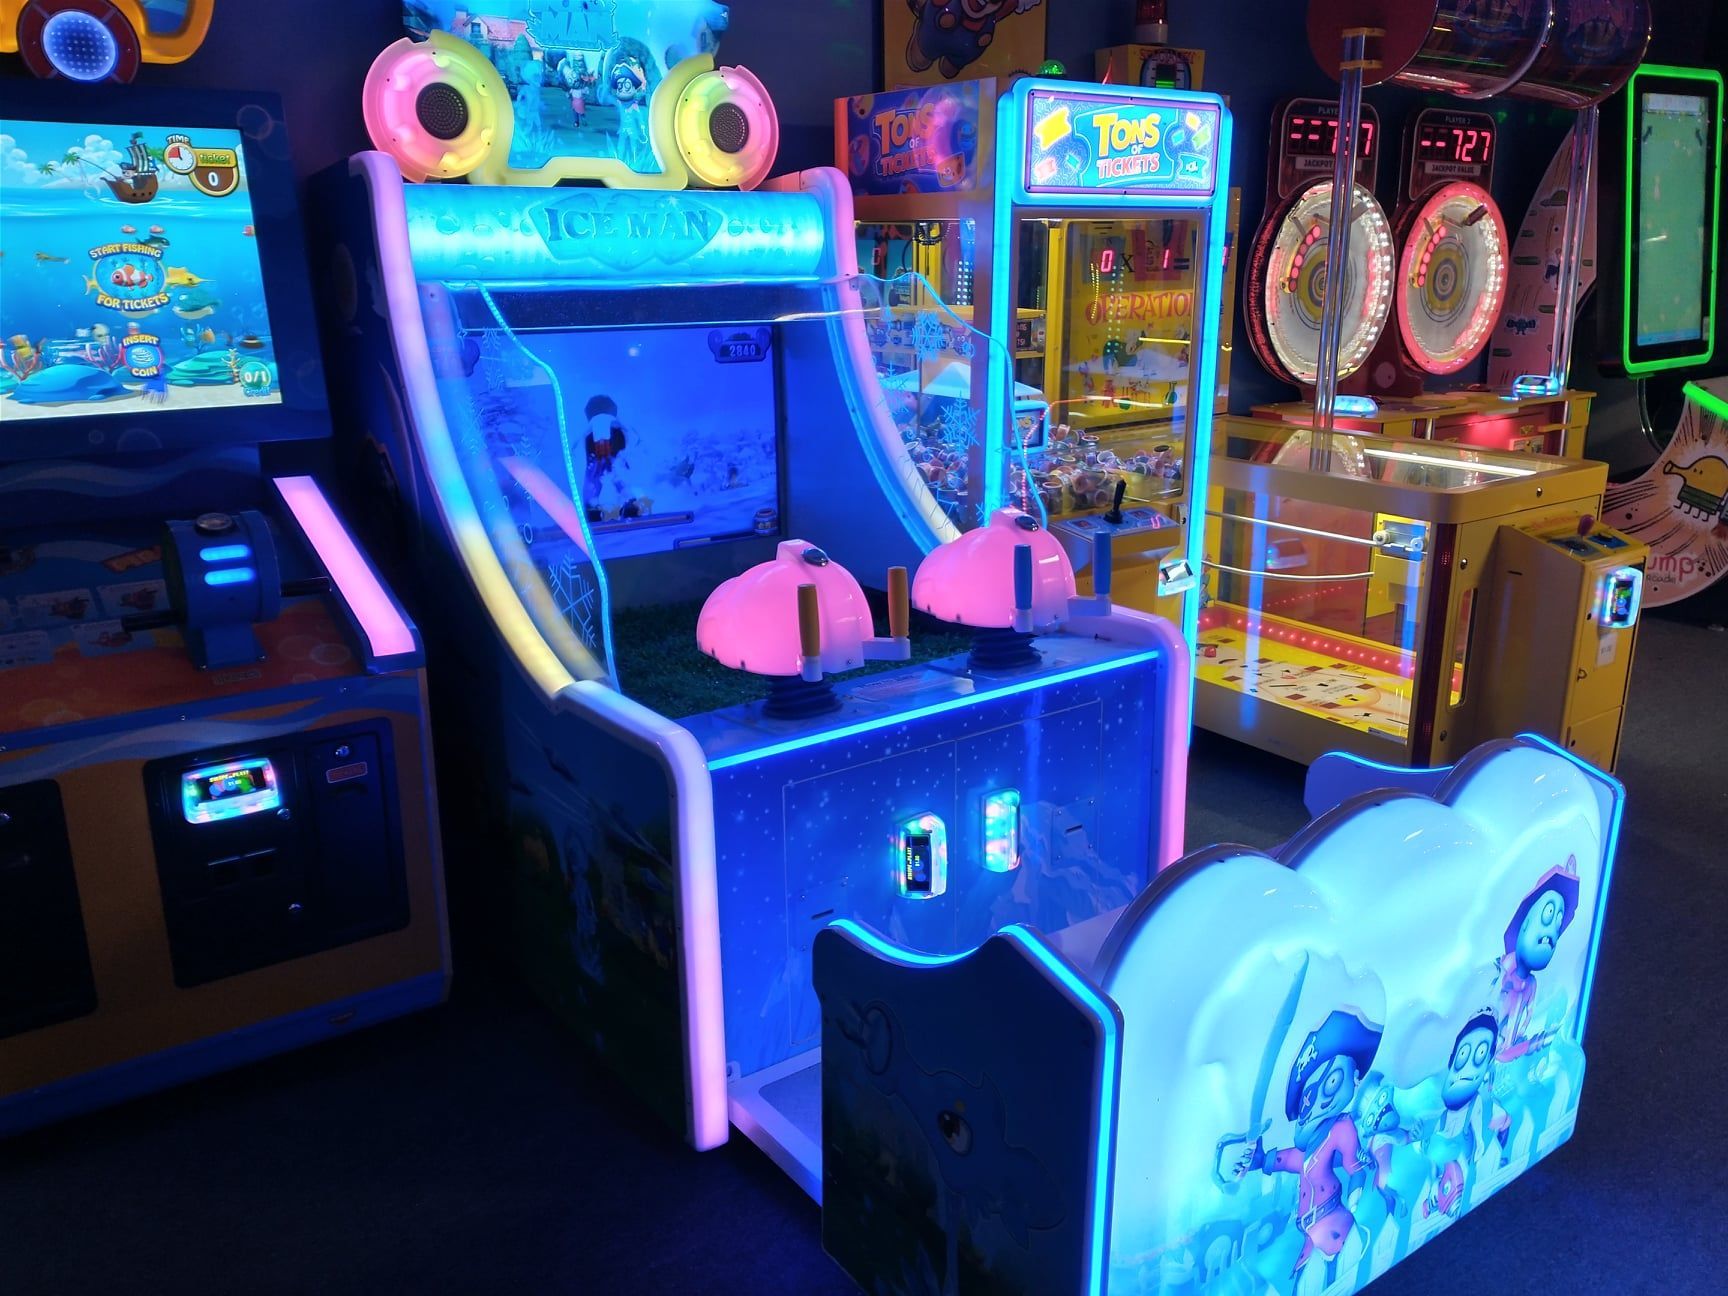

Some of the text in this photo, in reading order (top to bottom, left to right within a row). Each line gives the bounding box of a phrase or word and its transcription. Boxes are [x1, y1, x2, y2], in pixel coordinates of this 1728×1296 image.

[167, 134, 190, 144] TIME
[1093, 112, 1161, 157] TONS
[909, 137, 920, 149] OF
[1131, 143, 1145, 155] OF
[199, 153, 231, 165] ticket
[1096, 153, 1160, 179] TICKETS
[1431, 164, 1456, 173] JACKPOT
[208, 172, 219, 187] 0
[544, 207, 710, 241] ICE MAN
[89, 243, 162, 259] START FISHING
[97, 292, 169, 309] FOR TICKETS
[1085, 290, 1192, 326] OPERATIO
[123, 334, 159, 346] INSERT
[131, 367, 158, 377] COIN
